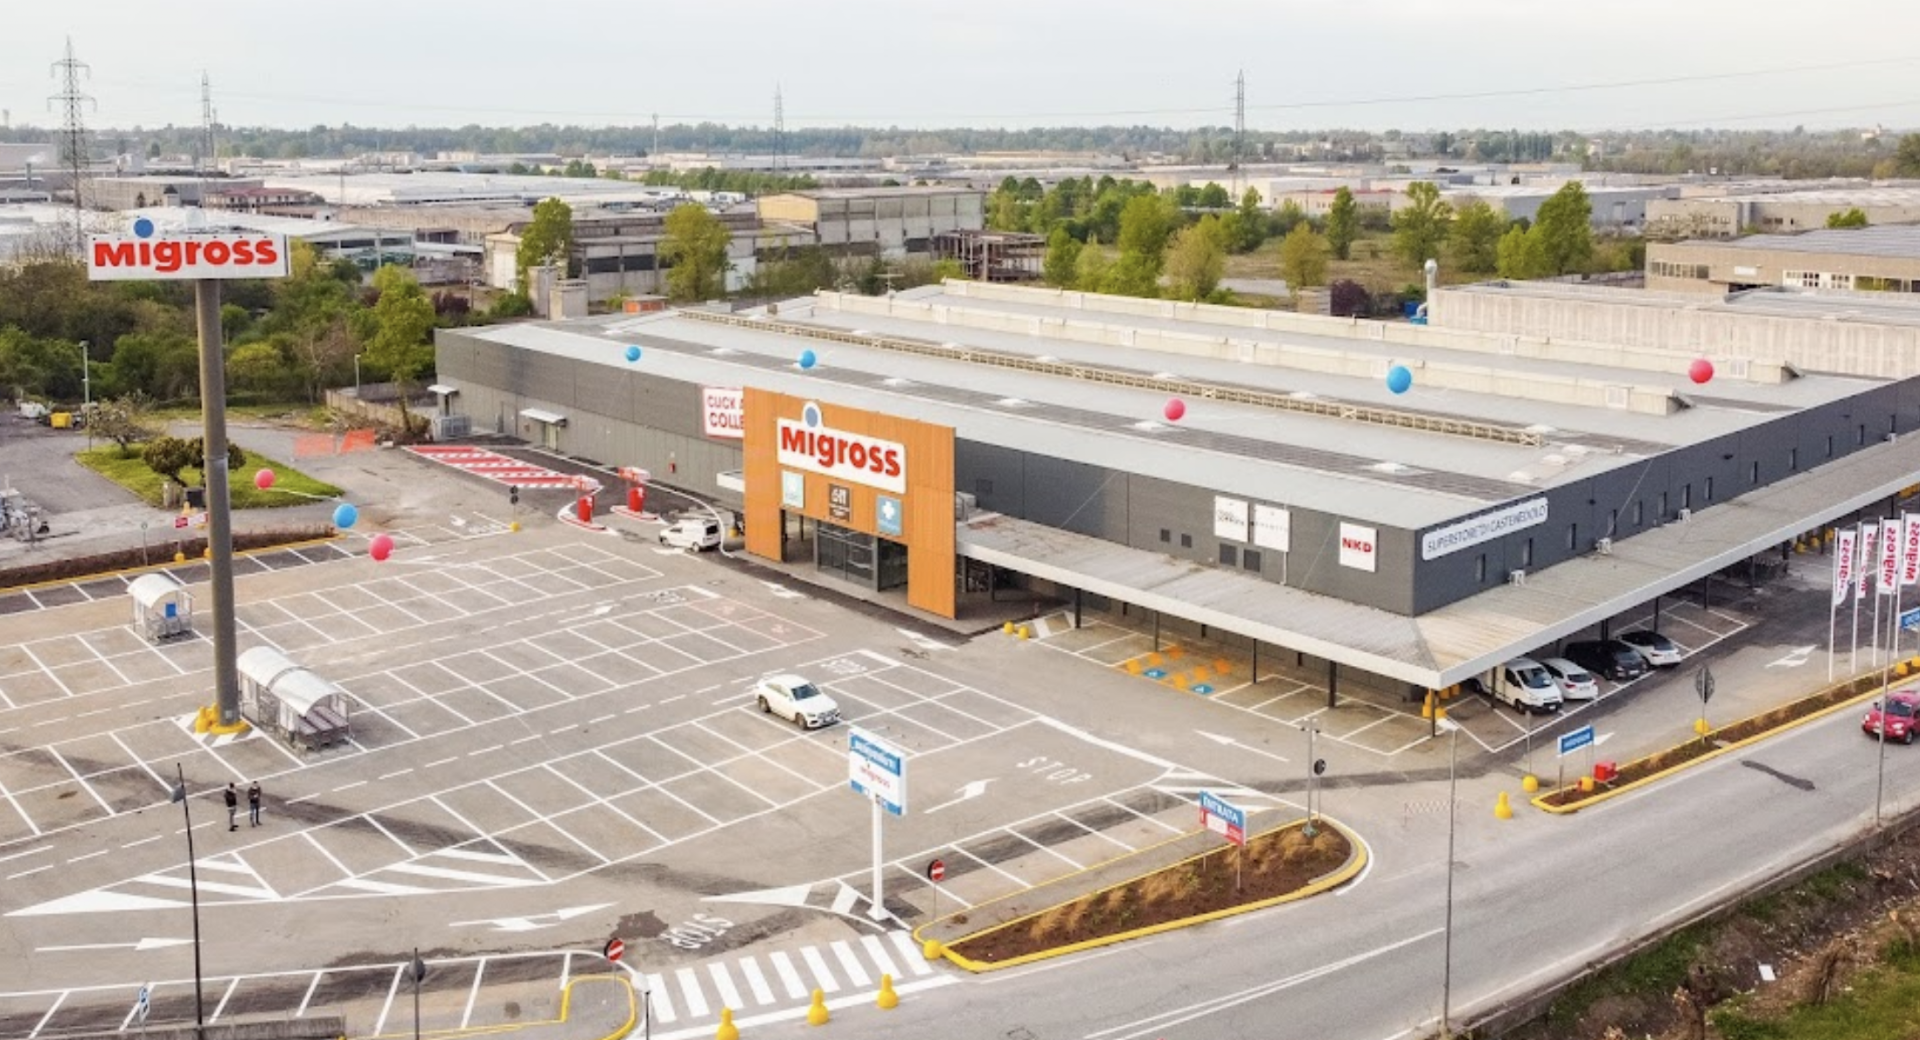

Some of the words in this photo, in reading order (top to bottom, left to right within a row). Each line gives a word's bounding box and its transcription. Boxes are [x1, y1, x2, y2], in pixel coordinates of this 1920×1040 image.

[94, 219, 277, 272] Migross
[781, 406, 901, 477] Migross
[1342, 537, 1372, 553] NKD
[1016, 756, 1092, 785] STOP
[660, 913, 734, 950] STOP
